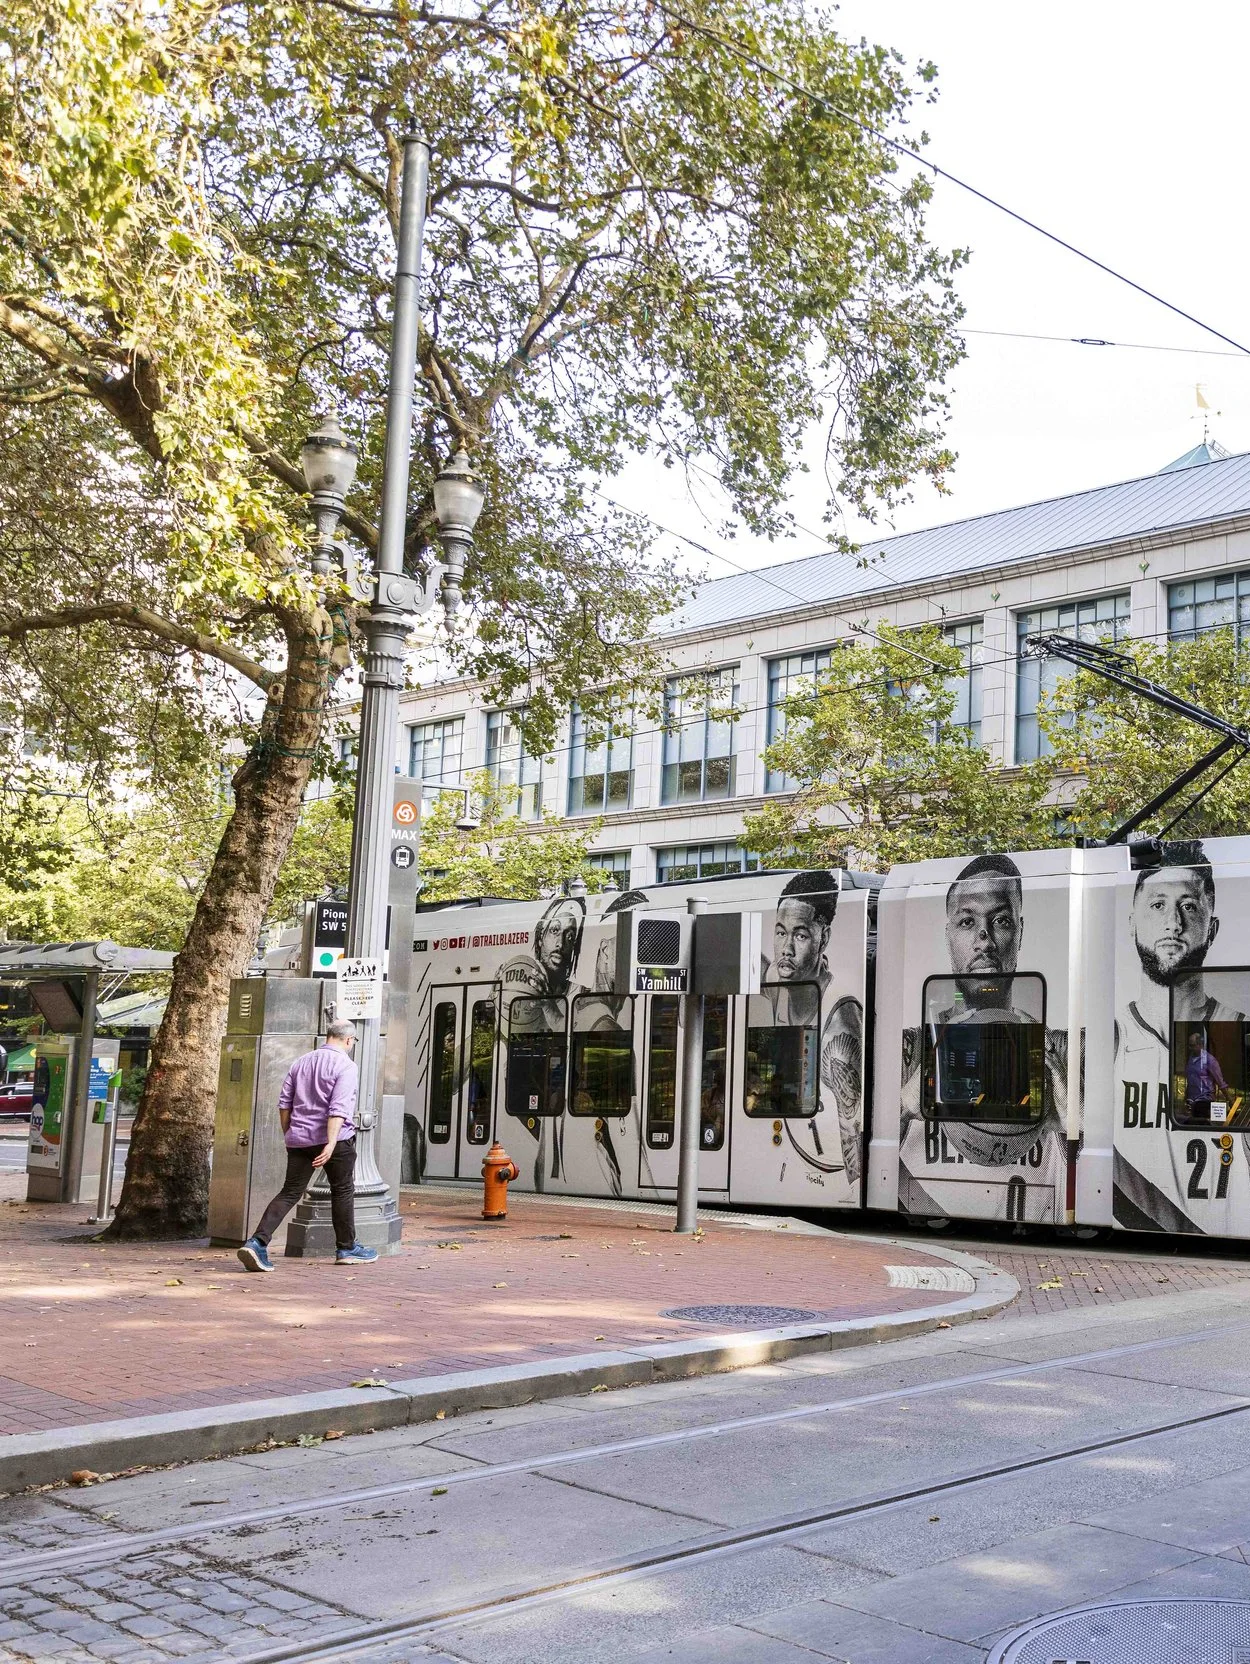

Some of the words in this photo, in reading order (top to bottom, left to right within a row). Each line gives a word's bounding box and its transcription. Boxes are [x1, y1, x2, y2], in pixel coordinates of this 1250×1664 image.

[391, 829, 417, 841] MAX
[322, 922, 338, 931] SW
[472, 932, 529, 947] @TRAILBLAZERS
[637, 968, 646, 976] SW
[641, 976, 681, 990] Yamhill
[1187, 1138, 1234, 1199] 27
